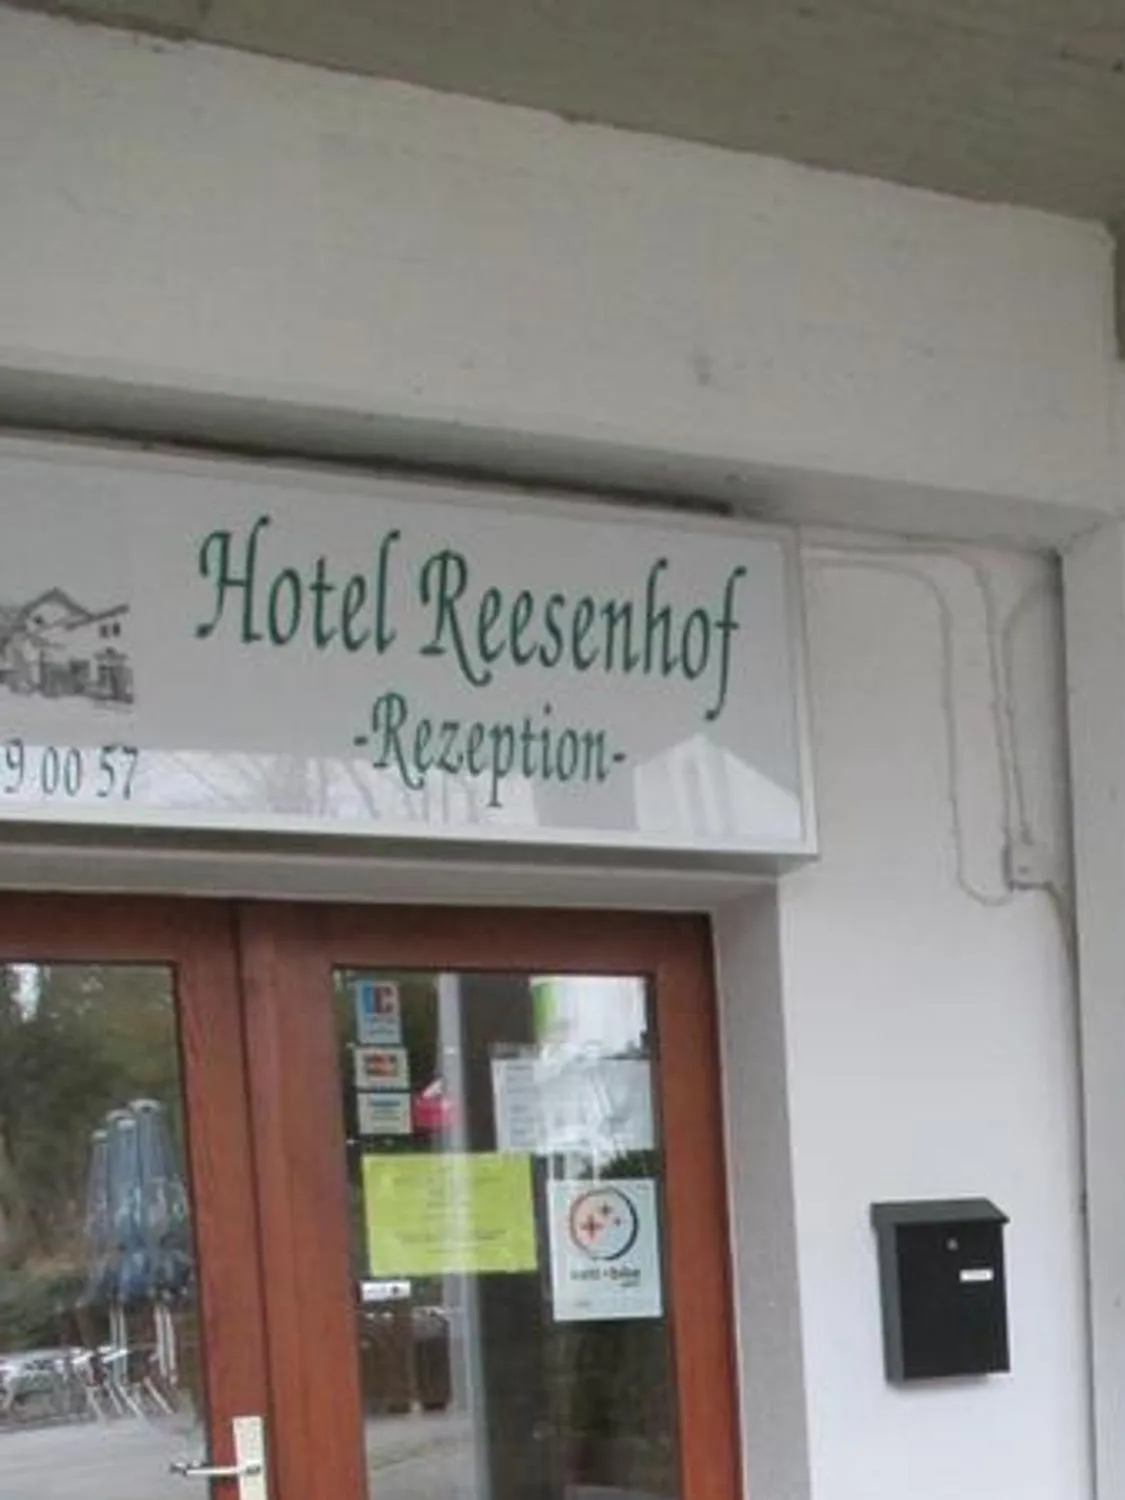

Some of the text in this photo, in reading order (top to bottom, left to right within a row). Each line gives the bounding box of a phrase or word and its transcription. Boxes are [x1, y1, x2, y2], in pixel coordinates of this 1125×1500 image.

[195, 515, 746, 721] Hotel Reesenhof
[96, 745, 138, 800] 57
